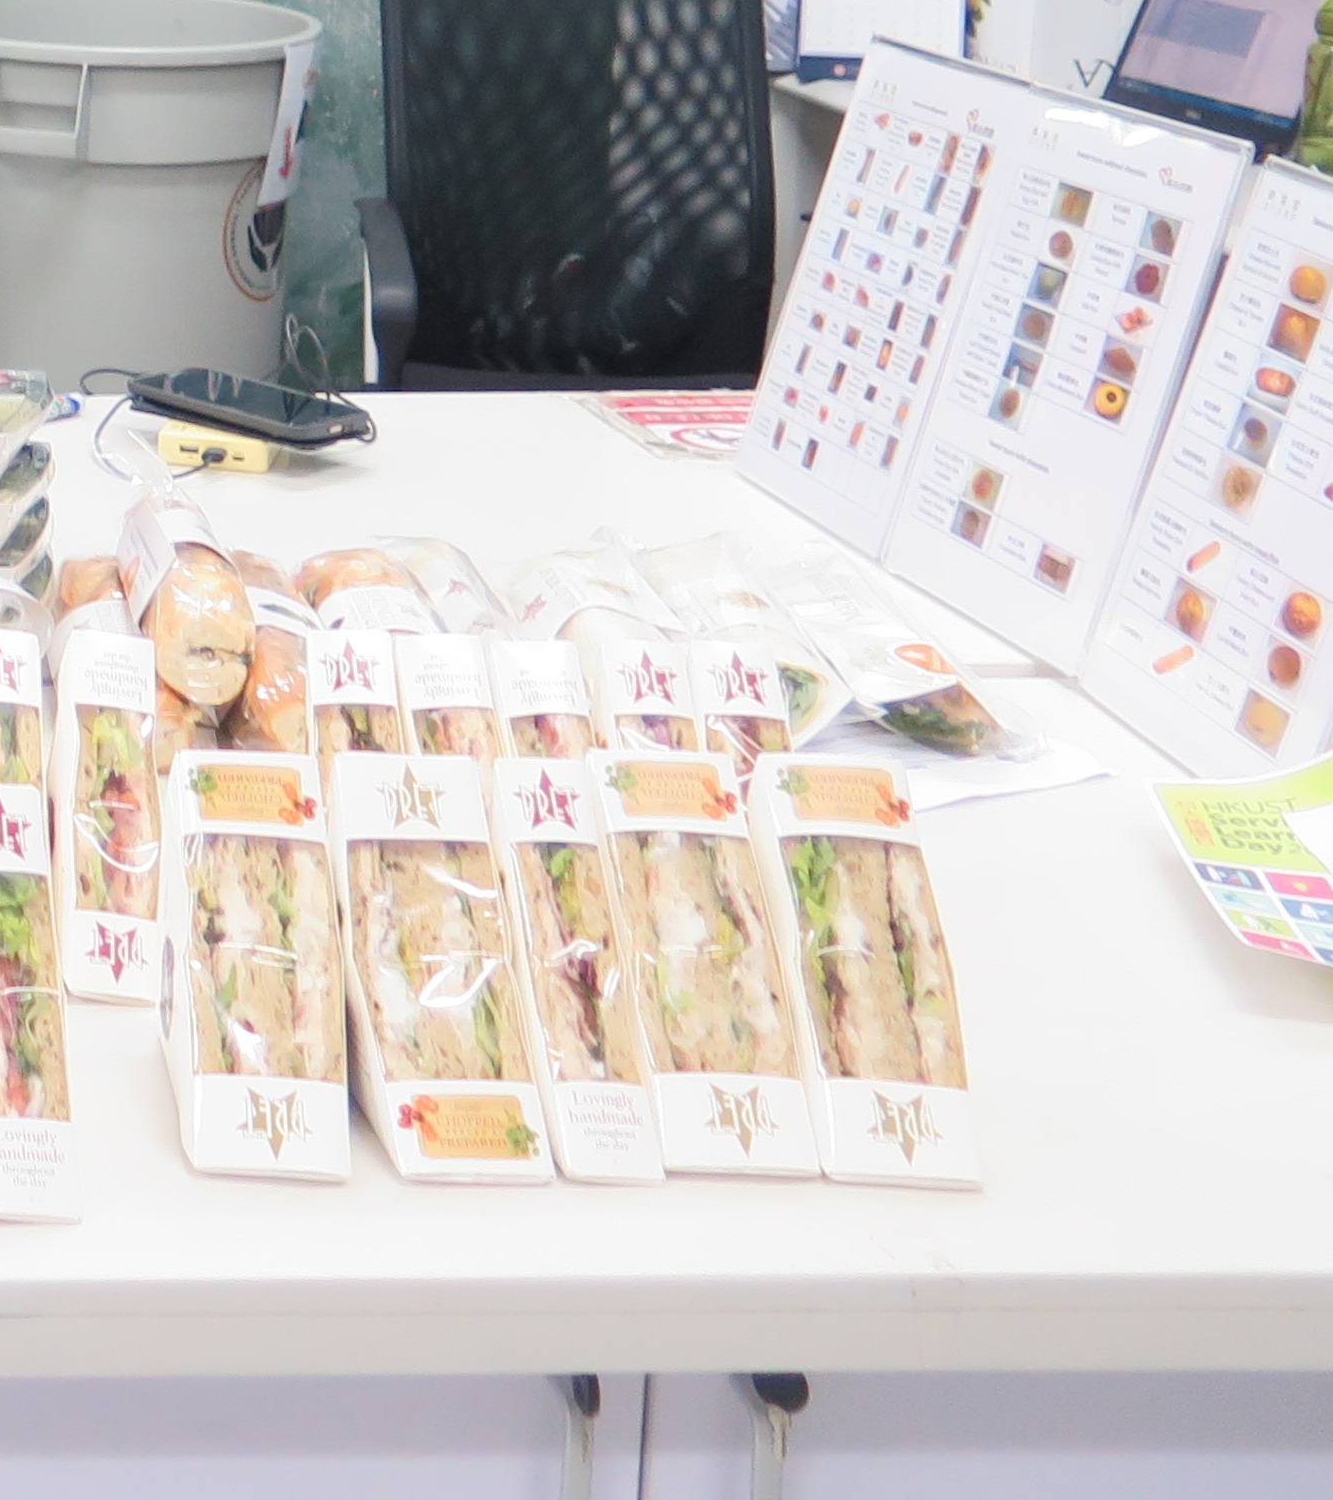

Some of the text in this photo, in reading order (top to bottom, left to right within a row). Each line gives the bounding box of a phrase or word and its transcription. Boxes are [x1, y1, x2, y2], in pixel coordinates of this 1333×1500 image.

[323, 653, 379, 688] PRET
[622, 665, 682, 700] PRET
[712, 665, 768, 700] PRET
[382, 781, 442, 820] PRET
[519, 787, 580, 821] PRET
[1201, 798, 1296, 816] HKUST
